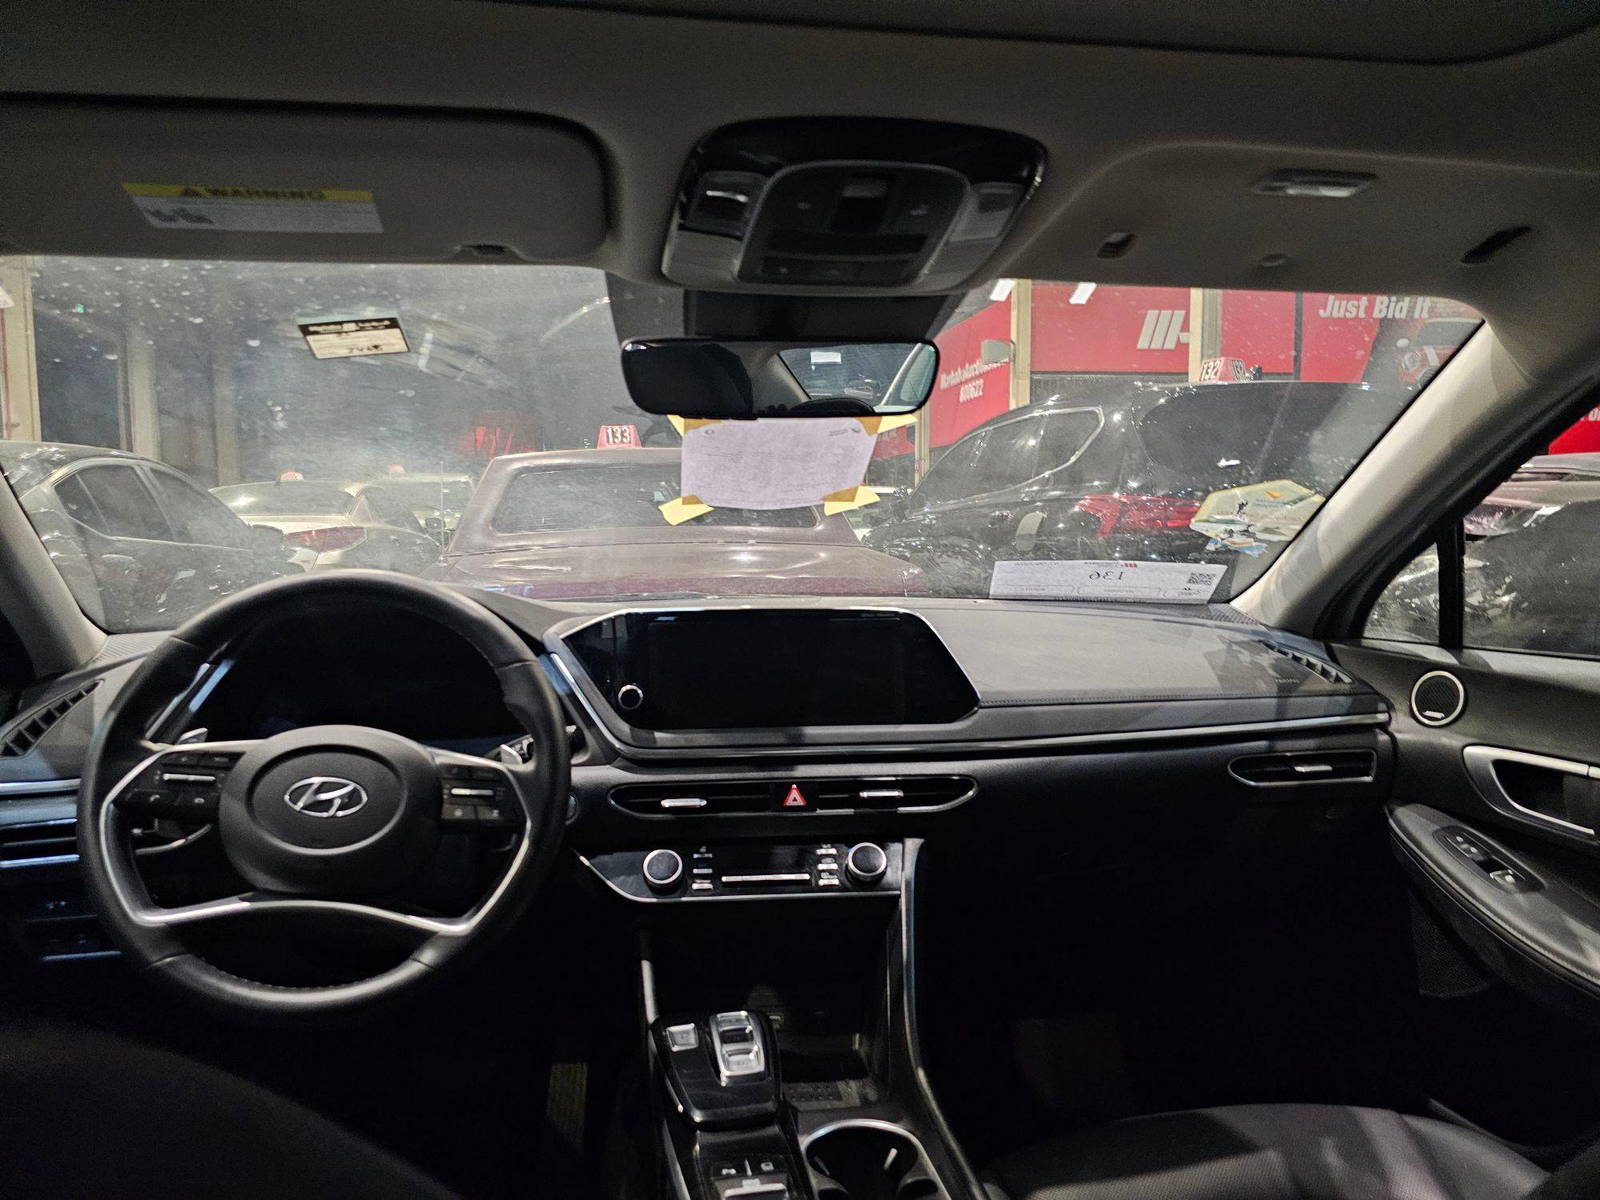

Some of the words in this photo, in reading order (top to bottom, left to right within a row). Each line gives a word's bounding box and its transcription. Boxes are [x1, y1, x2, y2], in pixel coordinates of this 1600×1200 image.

[1319, 295, 1369, 318] Just
[1373, 295, 1410, 319] Bid
[1413, 295, 1432, 318] It
[1201, 360, 1222, 381] 132
[606, 426, 630, 445] 133
